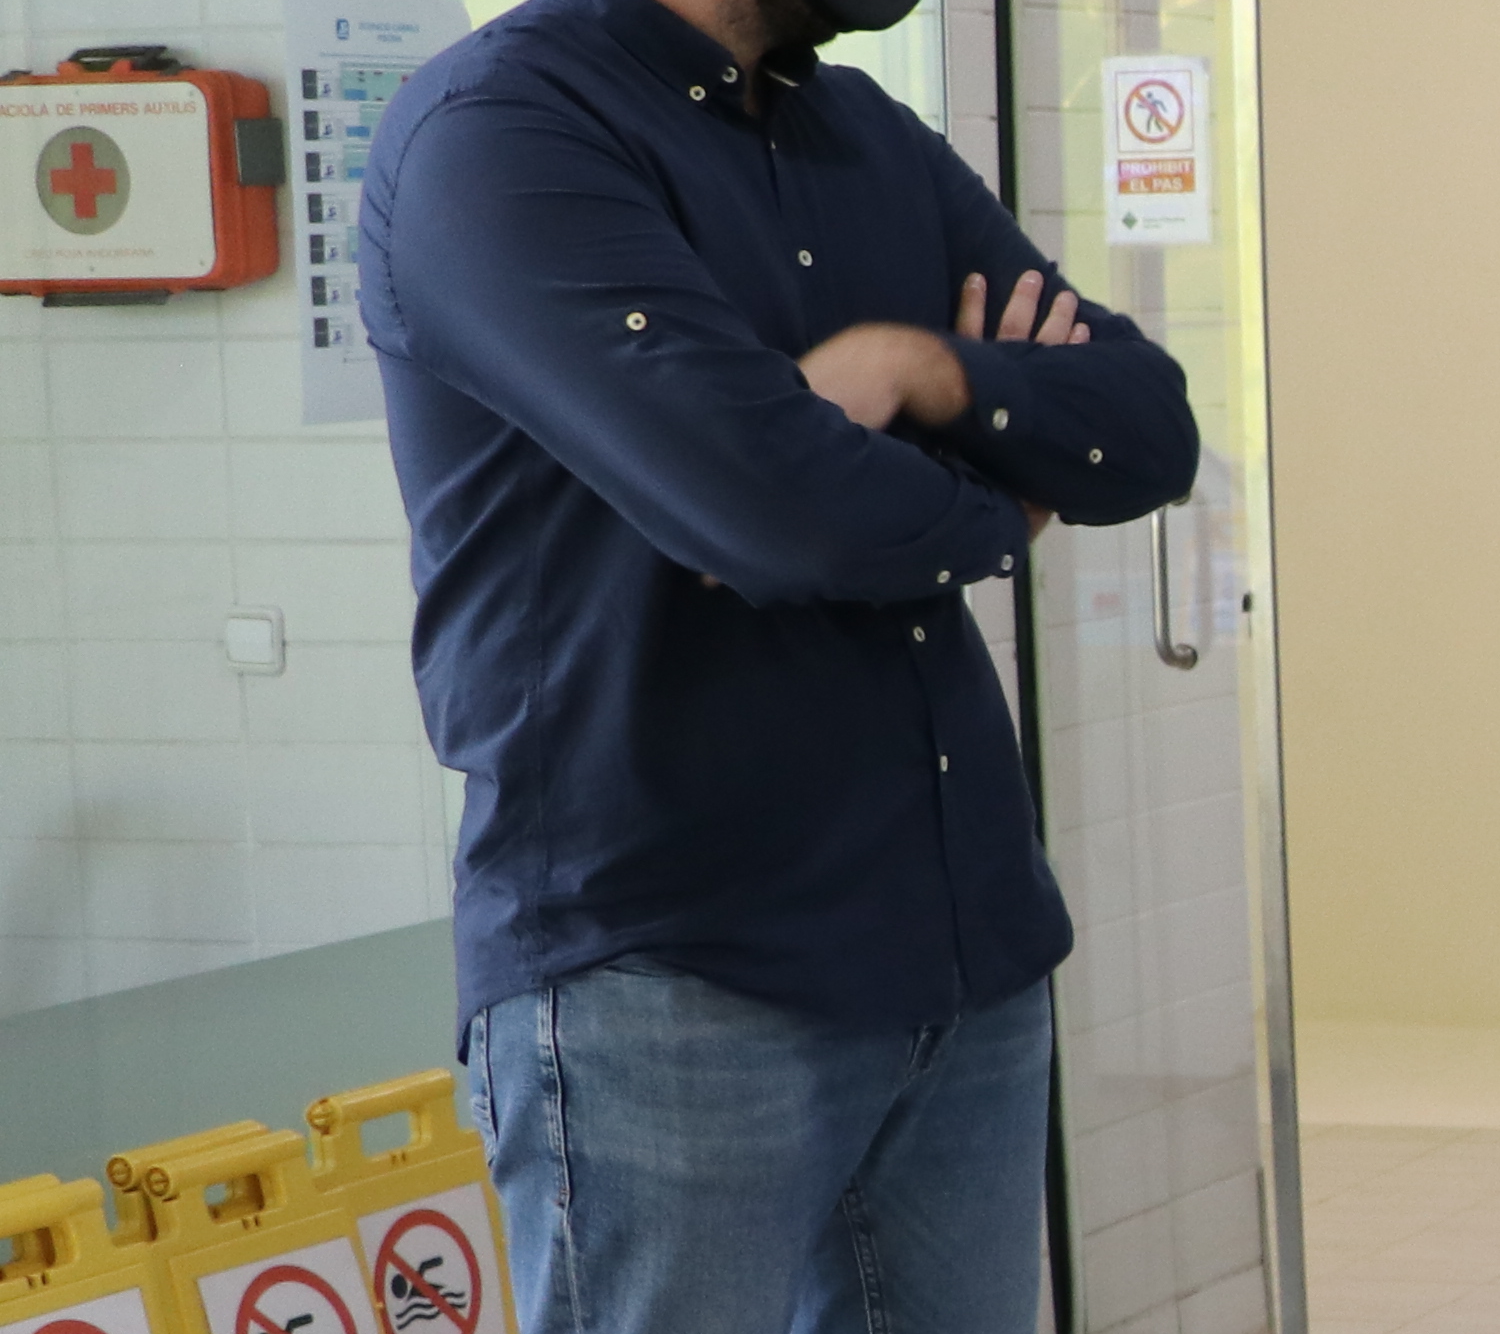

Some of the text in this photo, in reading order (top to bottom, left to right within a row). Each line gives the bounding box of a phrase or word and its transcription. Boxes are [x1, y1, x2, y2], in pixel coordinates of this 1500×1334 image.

[56, 103, 75, 116] DE
[80, 102, 139, 115] PRIMERS
[144, 100, 197, 114] AUXILIS
[1120, 161, 1192, 175] PROHIBIT
[1130, 176, 1183, 191] EL PAS
